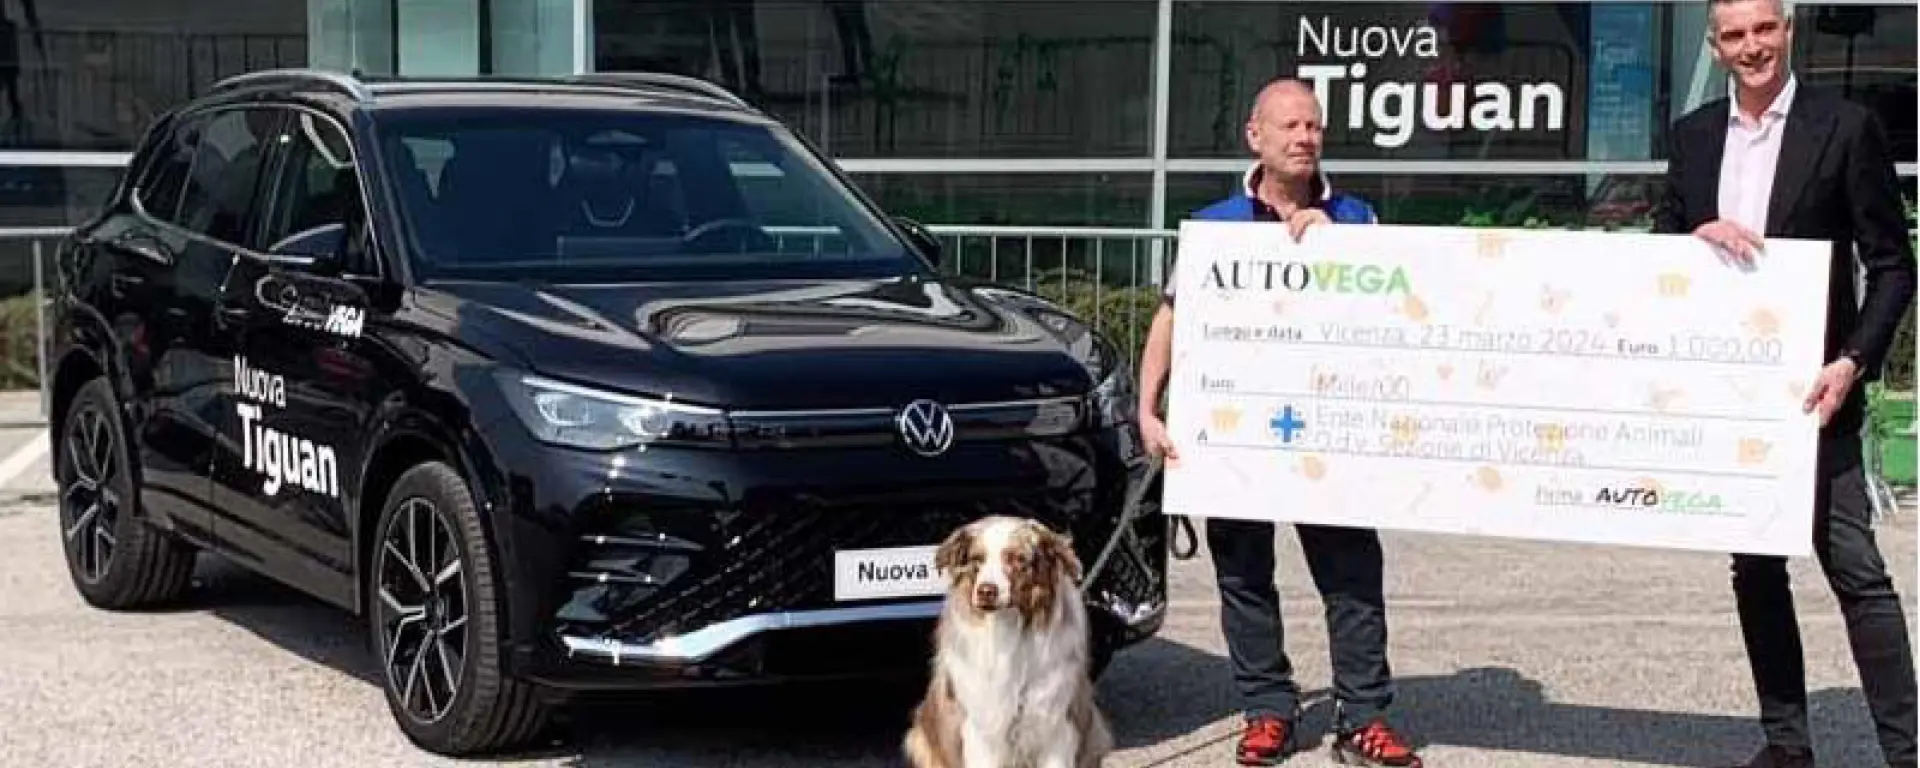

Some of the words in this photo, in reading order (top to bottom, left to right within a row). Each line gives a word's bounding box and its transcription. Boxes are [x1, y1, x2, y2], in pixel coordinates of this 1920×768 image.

[1298, 15, 1439, 57] Nuova
[1297, 62, 1564, 148] Tiguan
[1201, 260, 1412, 296] AUTOVEGA
[1420, 325, 1450, 348] 23
[1617, 338, 1660, 355] Euro
[234, 354, 287, 408] Nuova
[237, 403, 339, 498] Tiguan
[858, 561, 930, 583] Nuova
